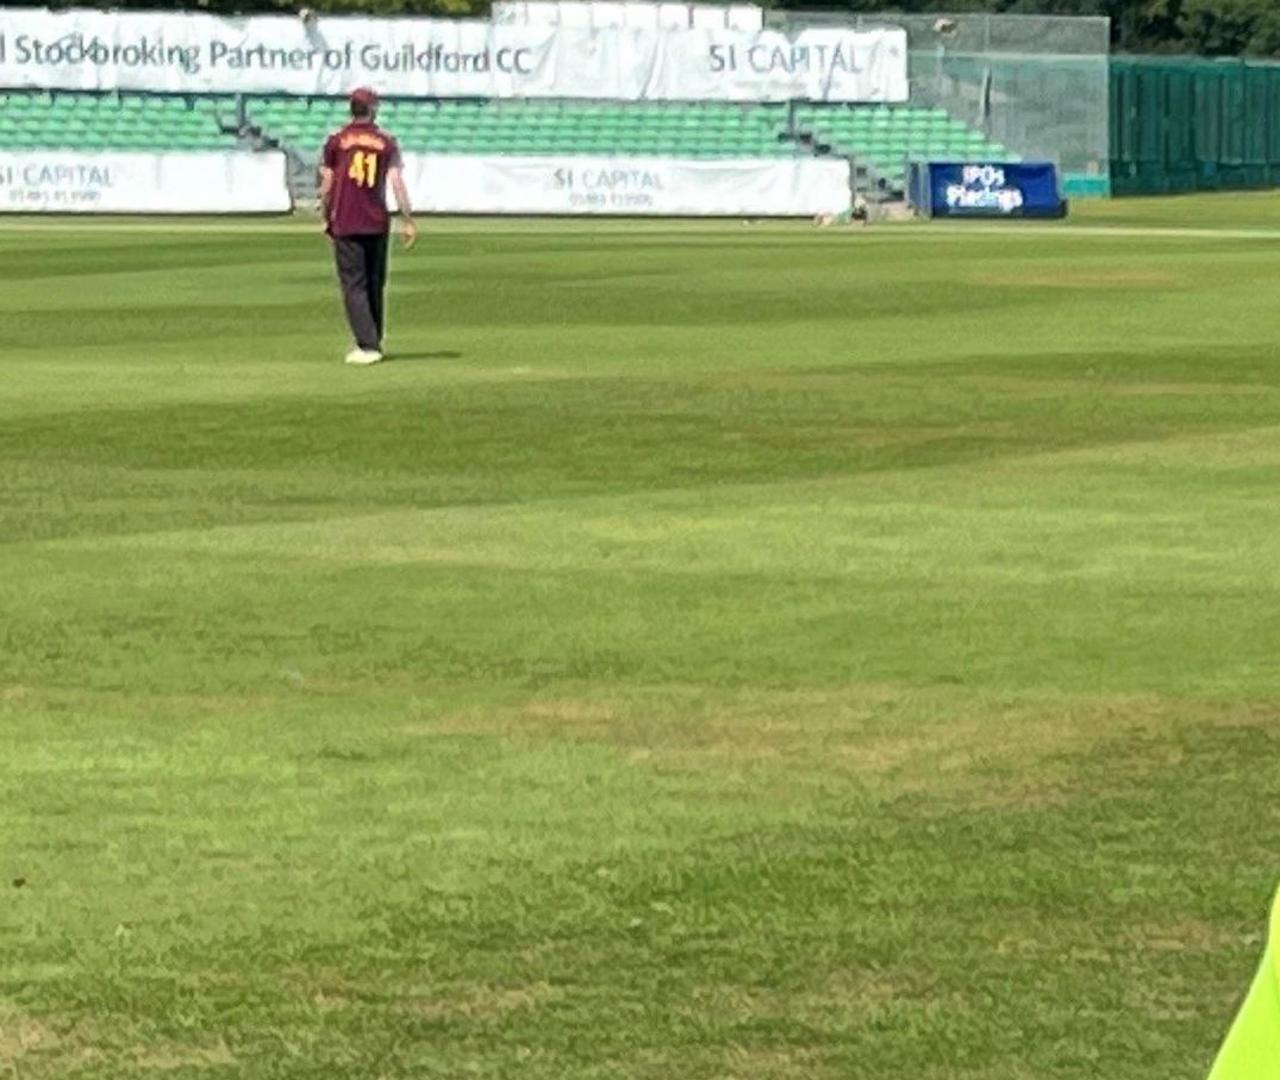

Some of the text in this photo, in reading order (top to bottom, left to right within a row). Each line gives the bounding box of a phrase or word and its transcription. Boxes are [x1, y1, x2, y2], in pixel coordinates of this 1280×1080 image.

[15, 33, 200, 74] Stockbroking
[209, 40, 320, 70] Partner
[323, 40, 353, 69] of
[361, 42, 491, 73] Guildford
[496, 47, 532, 73] CC
[709, 44, 863, 73] SI CAPITAL
[347, 150, 378, 188] 41
